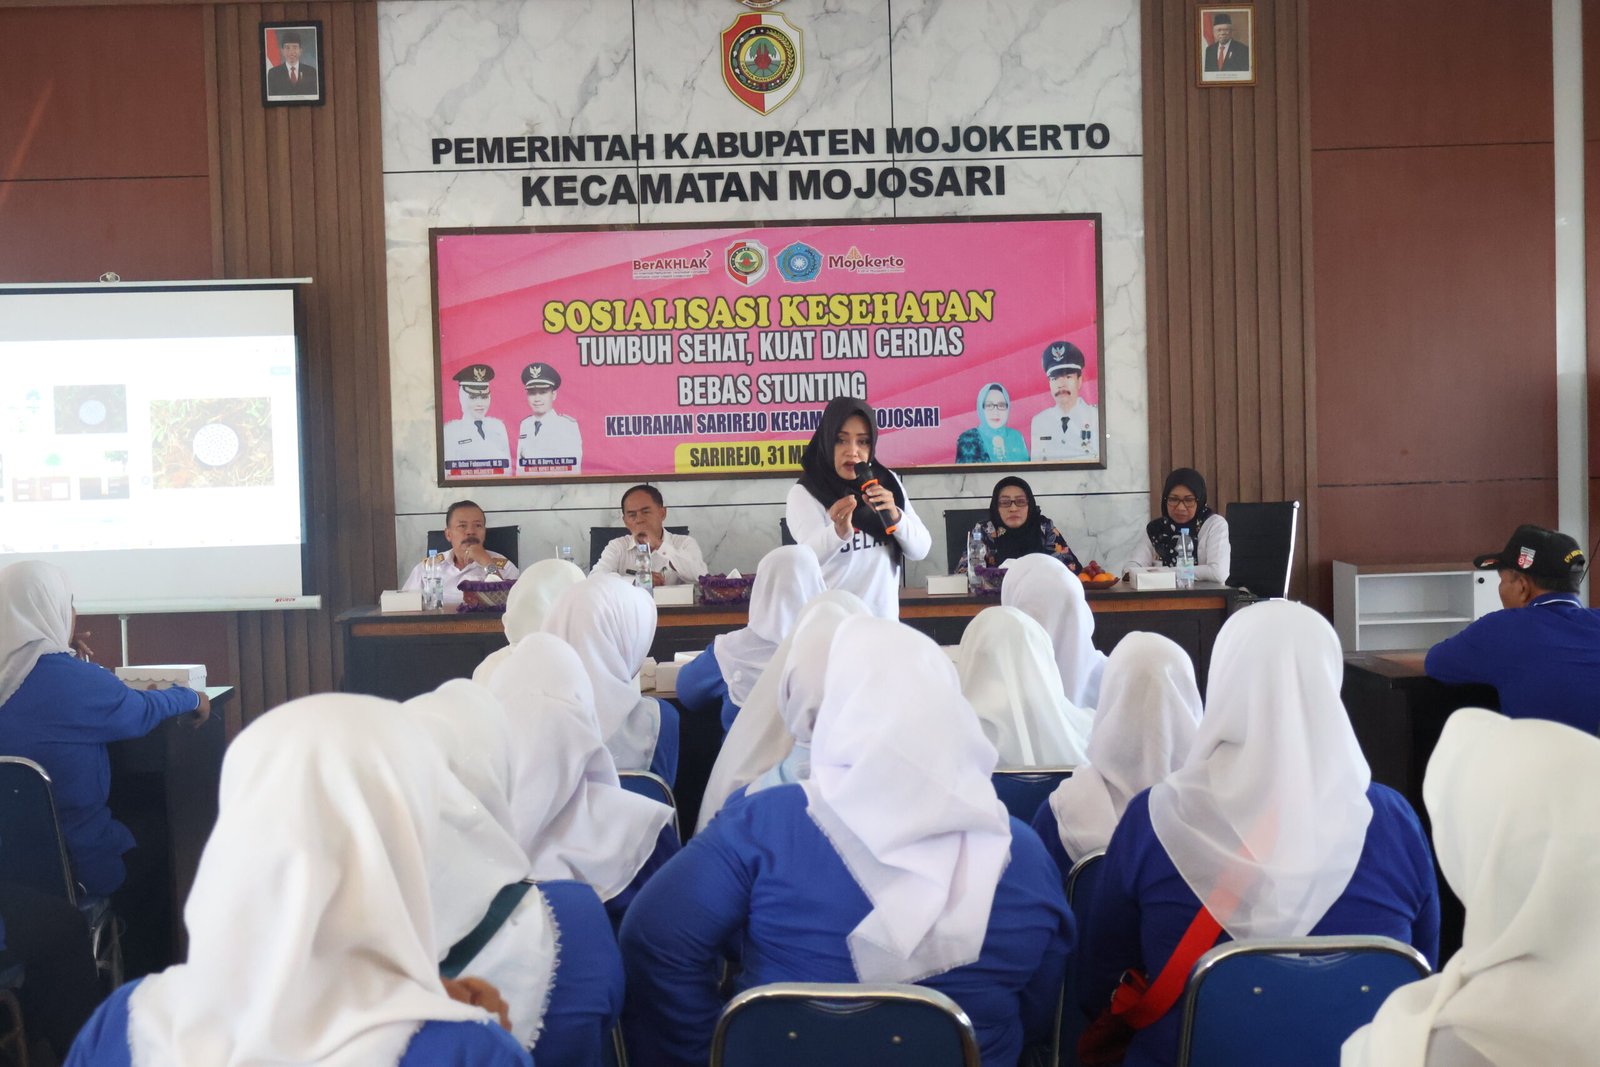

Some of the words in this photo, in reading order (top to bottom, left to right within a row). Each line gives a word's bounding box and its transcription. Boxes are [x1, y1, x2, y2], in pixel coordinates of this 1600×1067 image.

[432, 134, 654, 164] PEMERINTAH
[664, 128, 875, 160] KABUPATEN
[886, 123, 1110, 154] MOJOKERTO
[522, 171, 779, 207] KECAMATAN
[789, 165, 1006, 201] MOJOSARI
[633, 258, 707, 270] BerAKHLAK
[828, 255, 904, 271] Mojokerto
[543, 296, 771, 334] SOSIALISASI
[779, 289, 996, 327] KESEHATAN
[576, 333, 673, 366] TUMBUH
[678, 332, 754, 365] SEHAT,
[759, 329, 816, 361] KUAT
[821, 328, 869, 360] DAN
[873, 326, 965, 358] CERDAS
[678, 374, 752, 406] BEBAS
[757, 371, 868, 404] STUNTING
[606, 414, 693, 437] KELURAHAN
[697, 411, 767, 433] SARIREJO
[771, 410, 824, 432] KECAM
[873, 407, 939, 429] OJOSARI
[690, 446, 764, 468] SARIREJO,
[768, 445, 785, 465] 31
